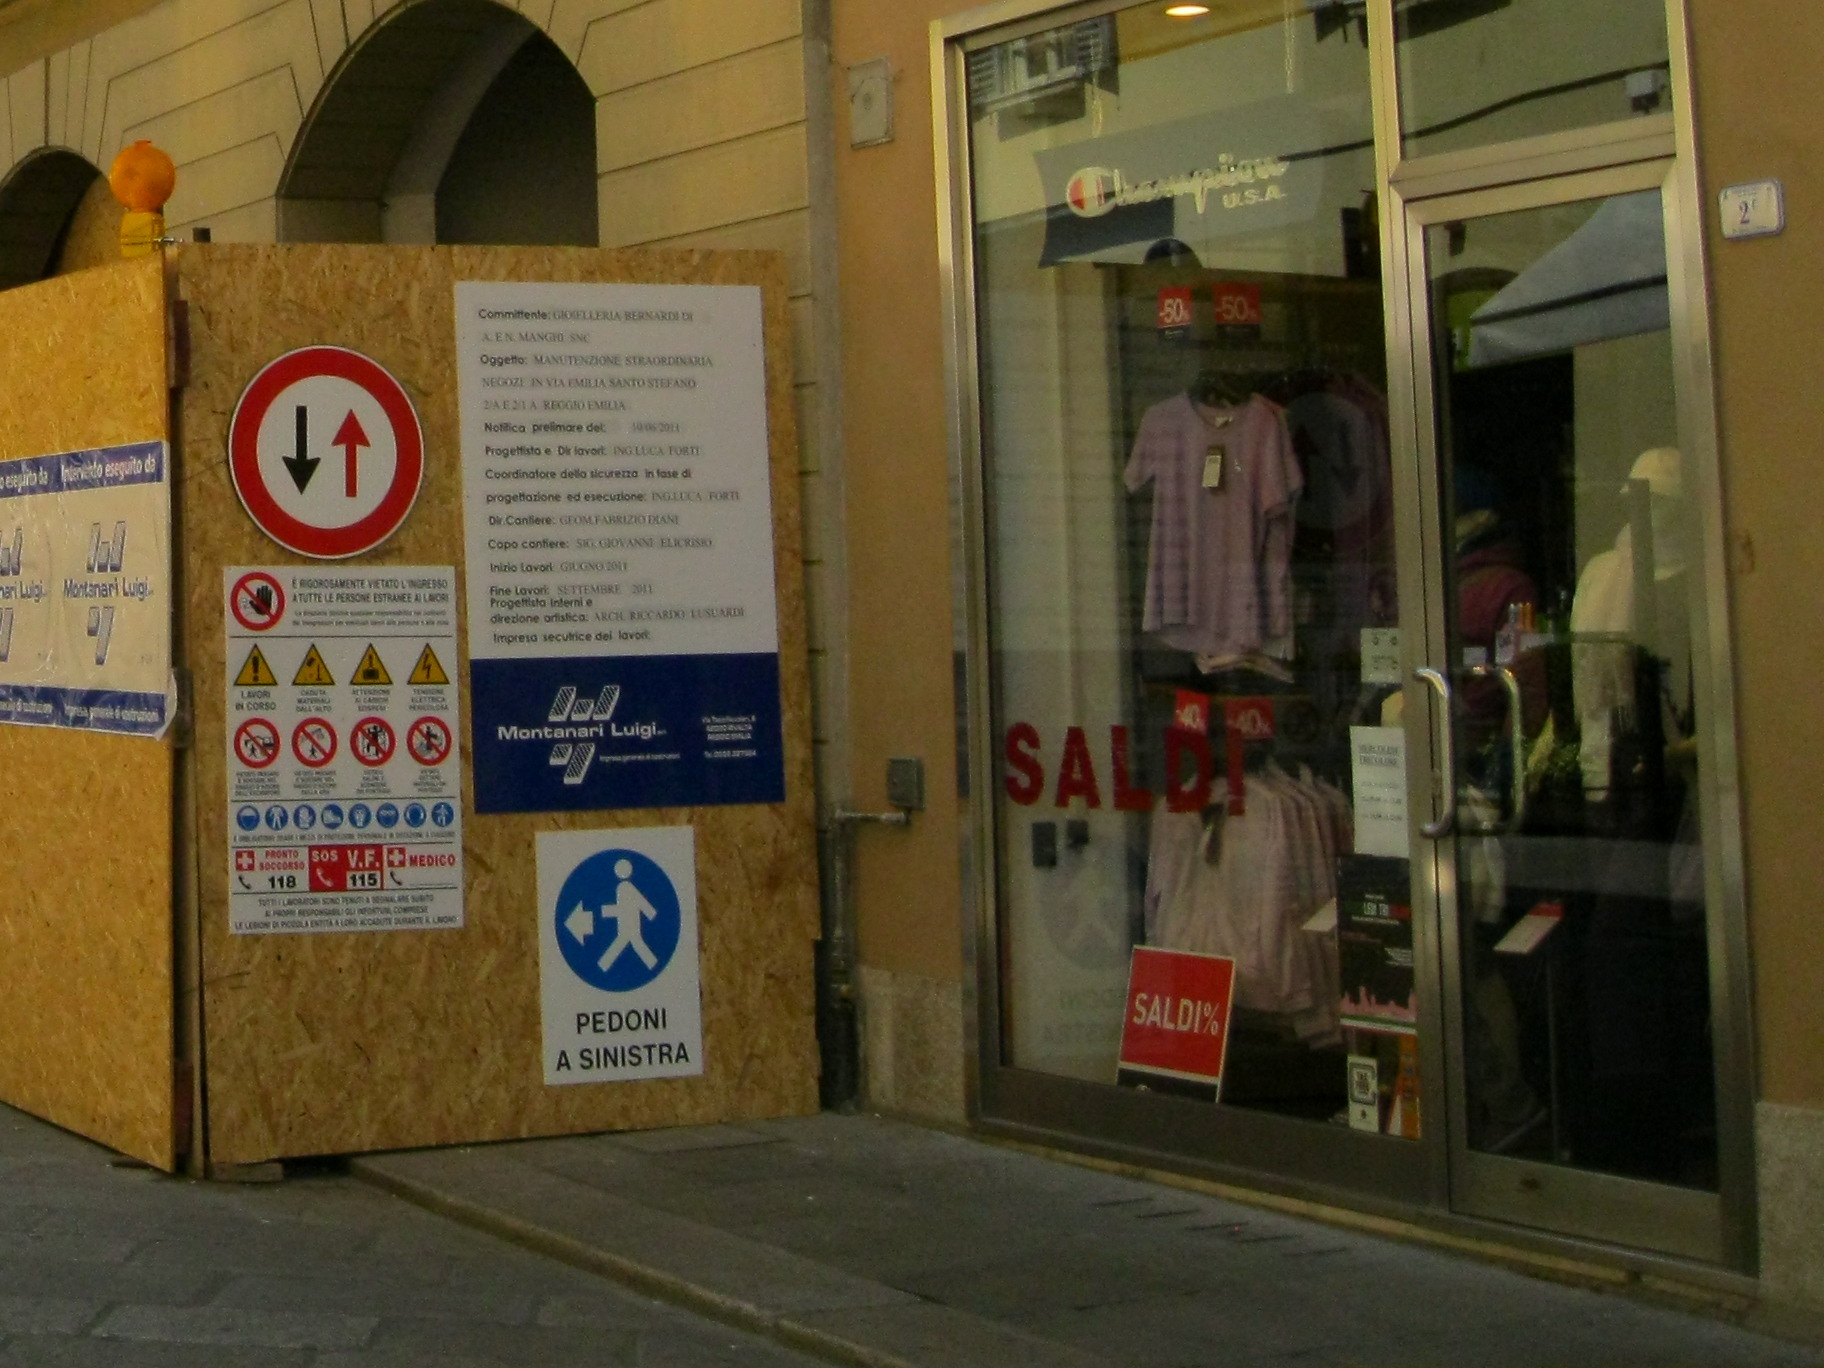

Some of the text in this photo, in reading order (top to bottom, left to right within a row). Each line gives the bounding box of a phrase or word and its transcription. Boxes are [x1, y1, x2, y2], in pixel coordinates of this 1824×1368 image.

[478, 309, 551, 321] Committente:
[480, 354, 714, 367] Oggetto: MANUTENZIONE STRAORDINARIA
[546, 378, 566, 388] VIA
[567, 378, 608, 389] EMILIA
[543, 400, 586, 411] REGGIO
[484, 422, 526, 433] Notifica
[485, 446, 542, 458] Progettista
[544, 448, 552, 456] e
[669, 446, 701, 457] FORTI
[60, 452, 157, 482] Intervento eseguito da
[485, 468, 557, 480] Coordinatore
[590, 468, 639, 479] sicurezza
[645, 468, 655, 478] in
[681, 468, 693, 478] di
[486, 491, 561, 505] progettazione
[566, 491, 581, 502] ed
[488, 539, 519, 551] Capo
[521, 538, 571, 550] cantiere:
[599, 537, 654, 549] GIOVANNI
[489, 562, 518, 573] Inizio
[19, 580, 45, 603] Luigi
[63, 576, 150, 601] Montanari Luigi
[489, 585, 512, 596] Fine
[557, 584, 621, 595] SETTEMBRE
[631, 583, 654, 594] 2011
[336, 592, 371, 603] PERSONE
[373, 592, 413, 603] ESTRANEE
[490, 597, 547, 610] Progettista
[586, 598, 593, 607] e
[490, 612, 540, 624] direzione
[630, 608, 686, 621] RICCARDO
[493, 631, 538, 645] Impresa
[246, 701, 277, 712] CORSO
[497, 721, 657, 741] Montanari Luigi
[1004, 720, 1247, 816] SALDI
[264, 849, 300, 860] PRONTO
[311, 850, 340, 863] SOS
[346, 849, 382, 869] V.F.
[408, 853, 457, 868] MEDICO
[258, 860, 306, 872] SOCCORSO
[268, 874, 297, 890] 118
[349, 872, 379, 888] 115
[1132, 991, 1220, 1036] SALDI%
[576, 1007, 668, 1035] PEDONI
[556, 1041, 690, 1072] A SINISTRA
